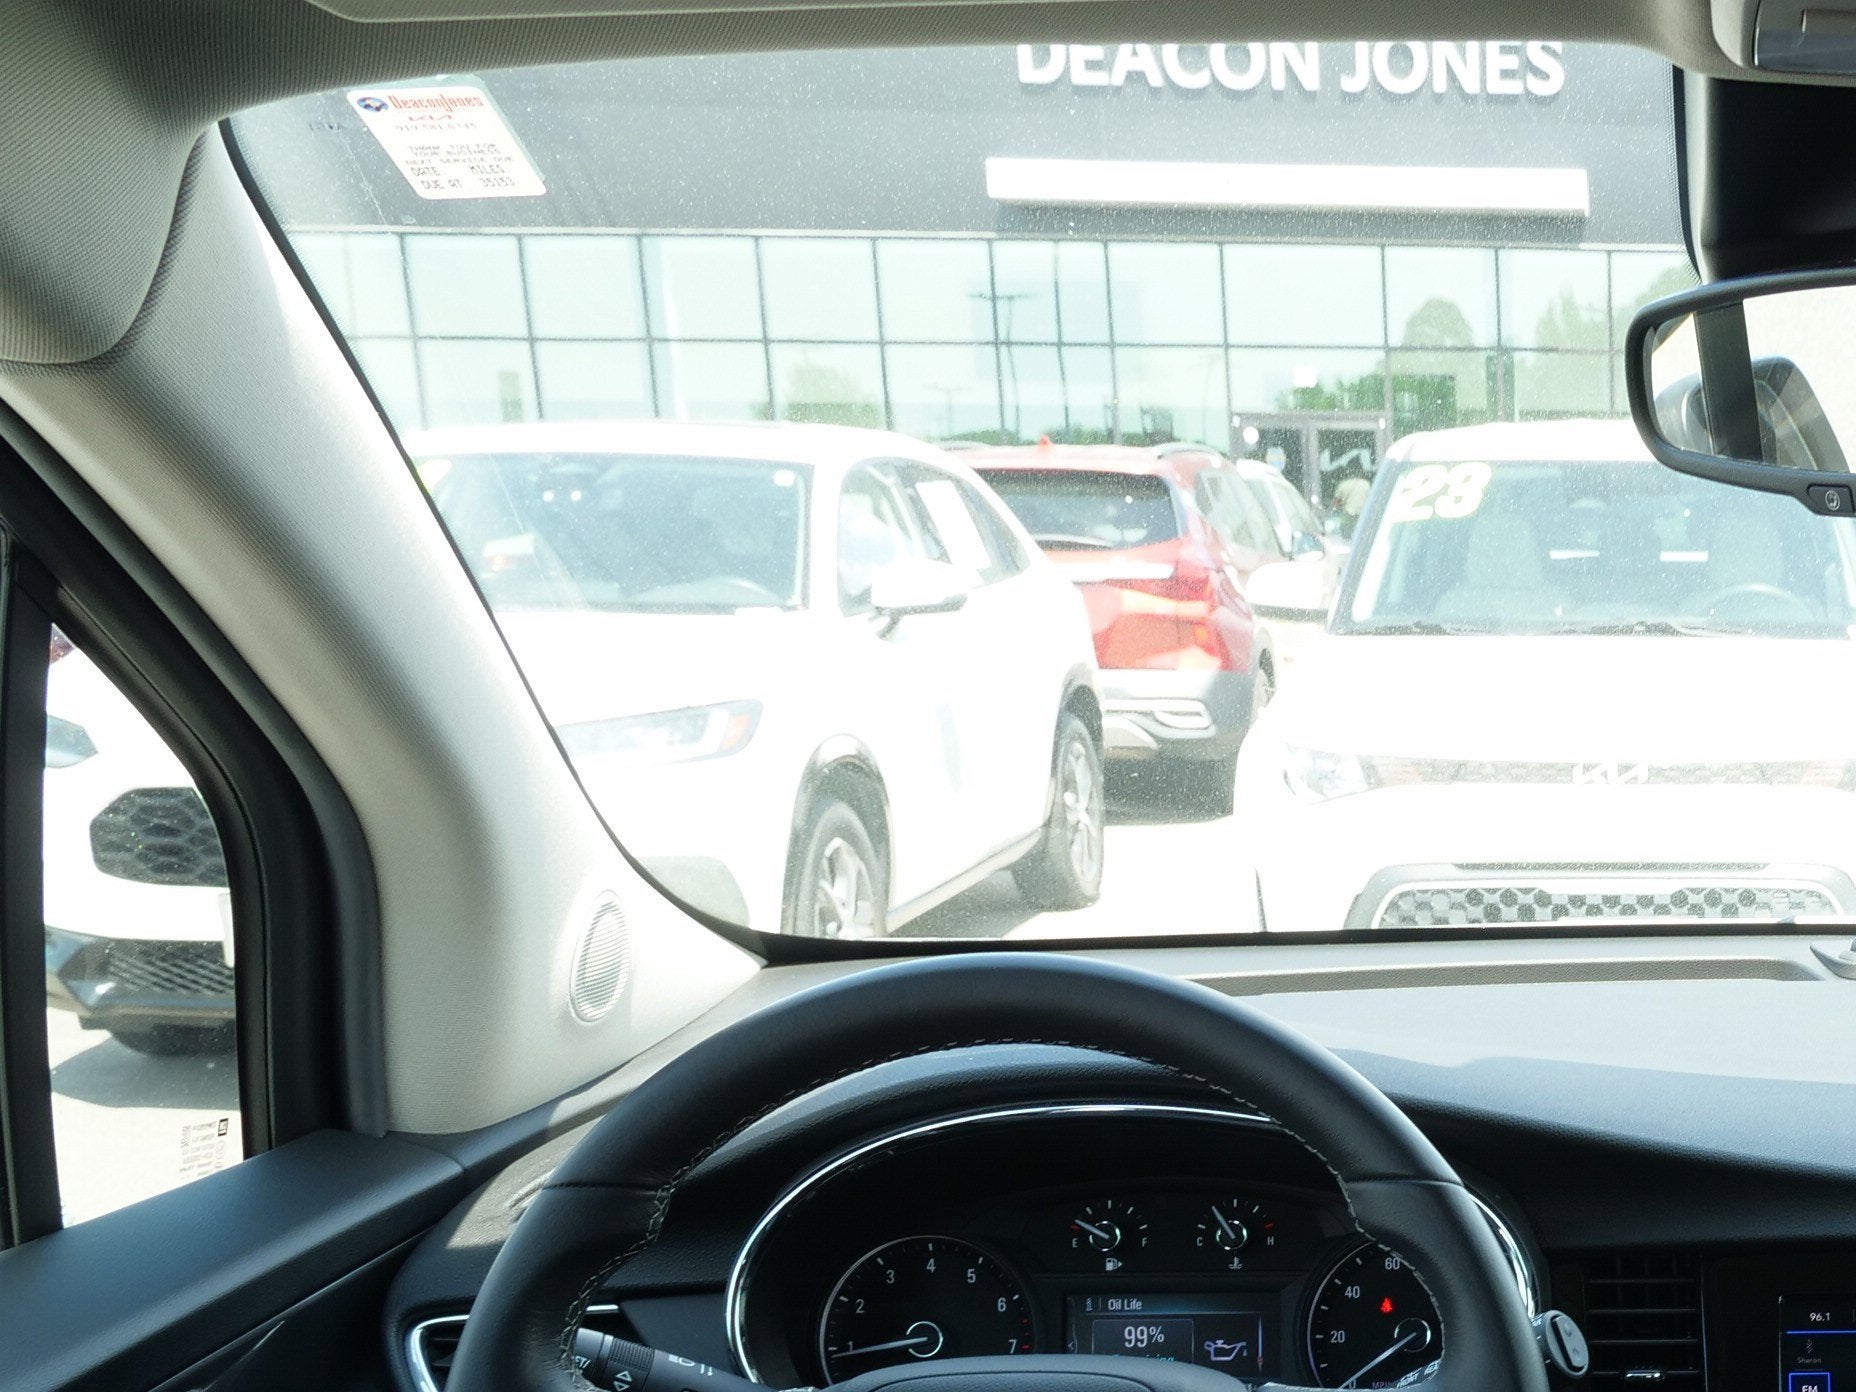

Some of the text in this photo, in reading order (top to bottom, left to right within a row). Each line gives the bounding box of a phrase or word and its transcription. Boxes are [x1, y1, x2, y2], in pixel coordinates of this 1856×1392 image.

[1016, 40, 1566, 96] DEACON JONES
[926, 1257, 936, 1273] 4
[1384, 1257, 1401, 1270] 60
[886, 1269, 895, 1284] 3
[966, 1268, 976, 1283] 5
[1344, 1286, 1361, 1299] 40
[855, 1298, 865, 1314] 2
[997, 1297, 1007, 1312] 6
[1108, 1298, 1142, 1310] Oil Life
[1809, 1312, 1831, 1322] 96.1
[1124, 1325, 1165, 1348] 99%
[1330, 1330, 1346, 1343] 20
